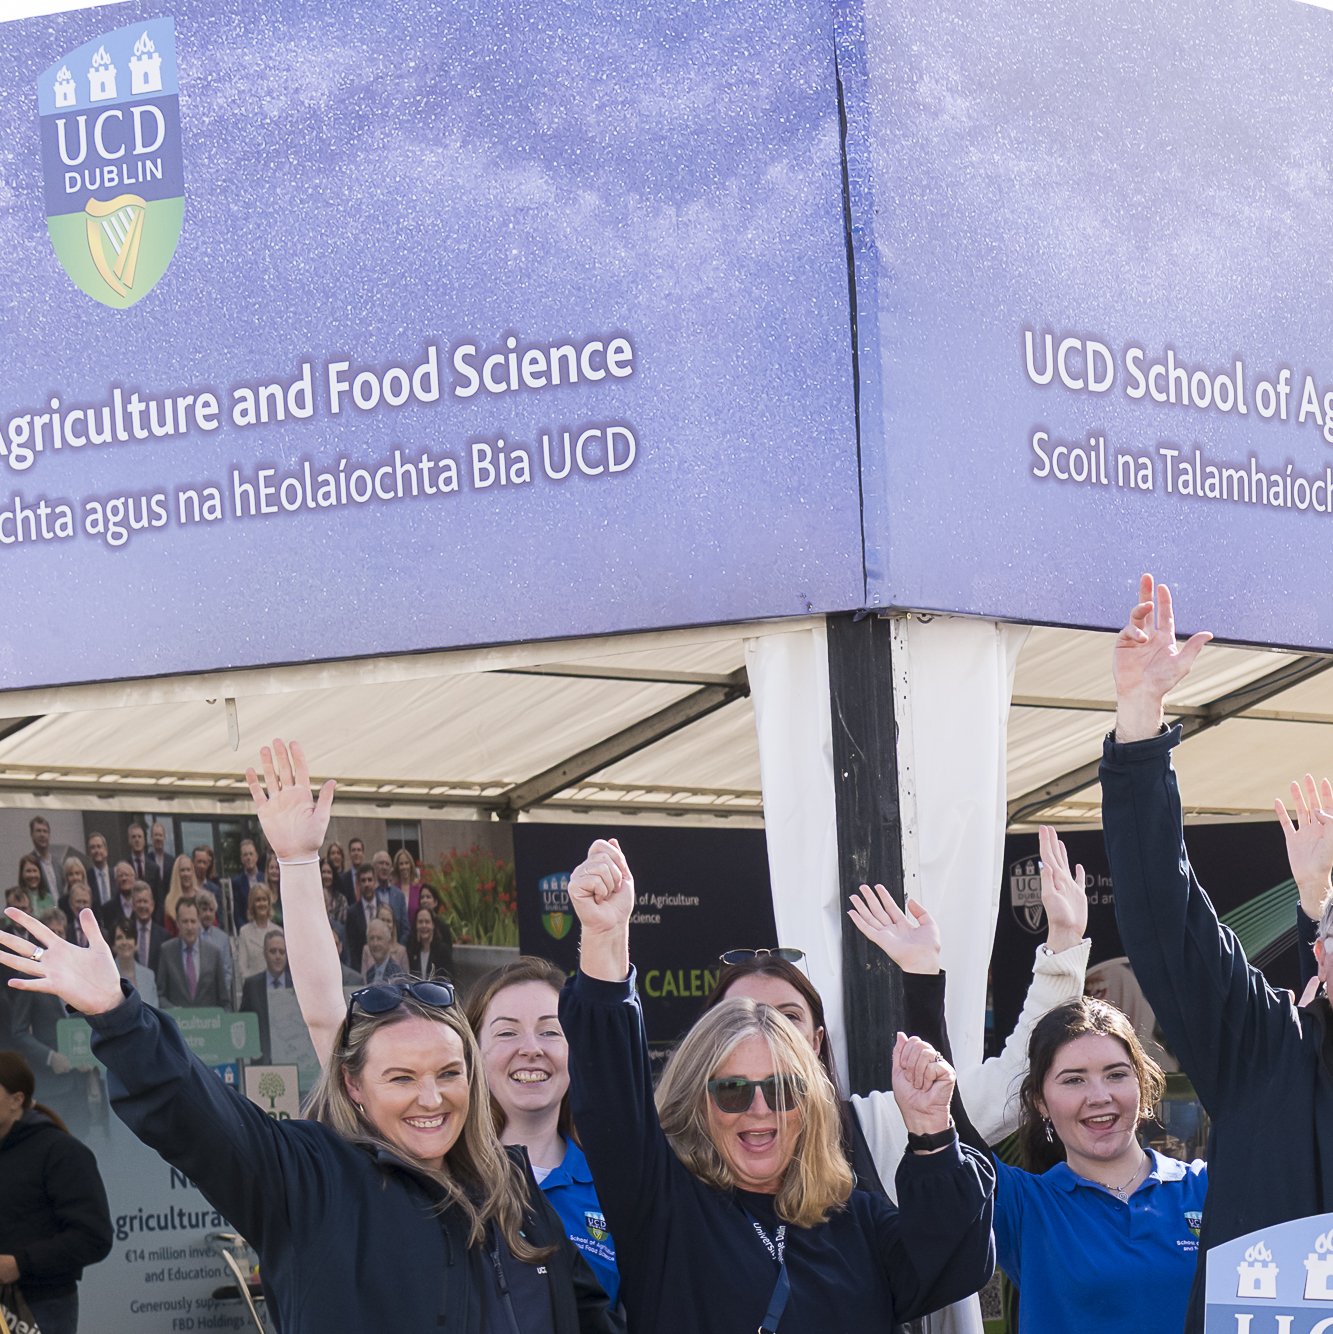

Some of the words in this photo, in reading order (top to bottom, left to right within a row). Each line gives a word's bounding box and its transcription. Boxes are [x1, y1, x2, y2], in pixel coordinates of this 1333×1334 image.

[55, 104, 166, 167] UCD
[64, 158, 164, 194] DUBLIN
[232, 362, 314, 427] and
[329, 346, 440, 414] Food
[454, 335, 635, 400] Science
[1025, 331, 1115, 394] UCD
[1126, 348, 1247, 416] School
[1255, 370, 1291, 417] of
[1032, 433, 1107, 487] Scoil
[1117, 452, 1153, 490] na
[84, 492, 169, 547] agus
[178, 486, 223, 525] na
[233, 449, 460, 517] hEolaíochta
[472, 438, 531, 489] Bia
[543, 426, 637, 478] UCD
[543, 892, 569, 904] UCD
[1017, 877, 1038, 893] UC
[639, 893, 649, 905] of
[650, 893, 699, 908] Agriculture
[645, 969, 720, 998] CALEN
[116, 1205, 232, 1241] gricultura
[149, 1246, 187, 1262] million
[145, 1269, 165, 1283] and
[169, 1266, 221, 1282] Education
[130, 1297, 193, 1314] Generously
[172, 1319, 195, 1331] FBD
[198, 1315, 245, 1330] Holdings
